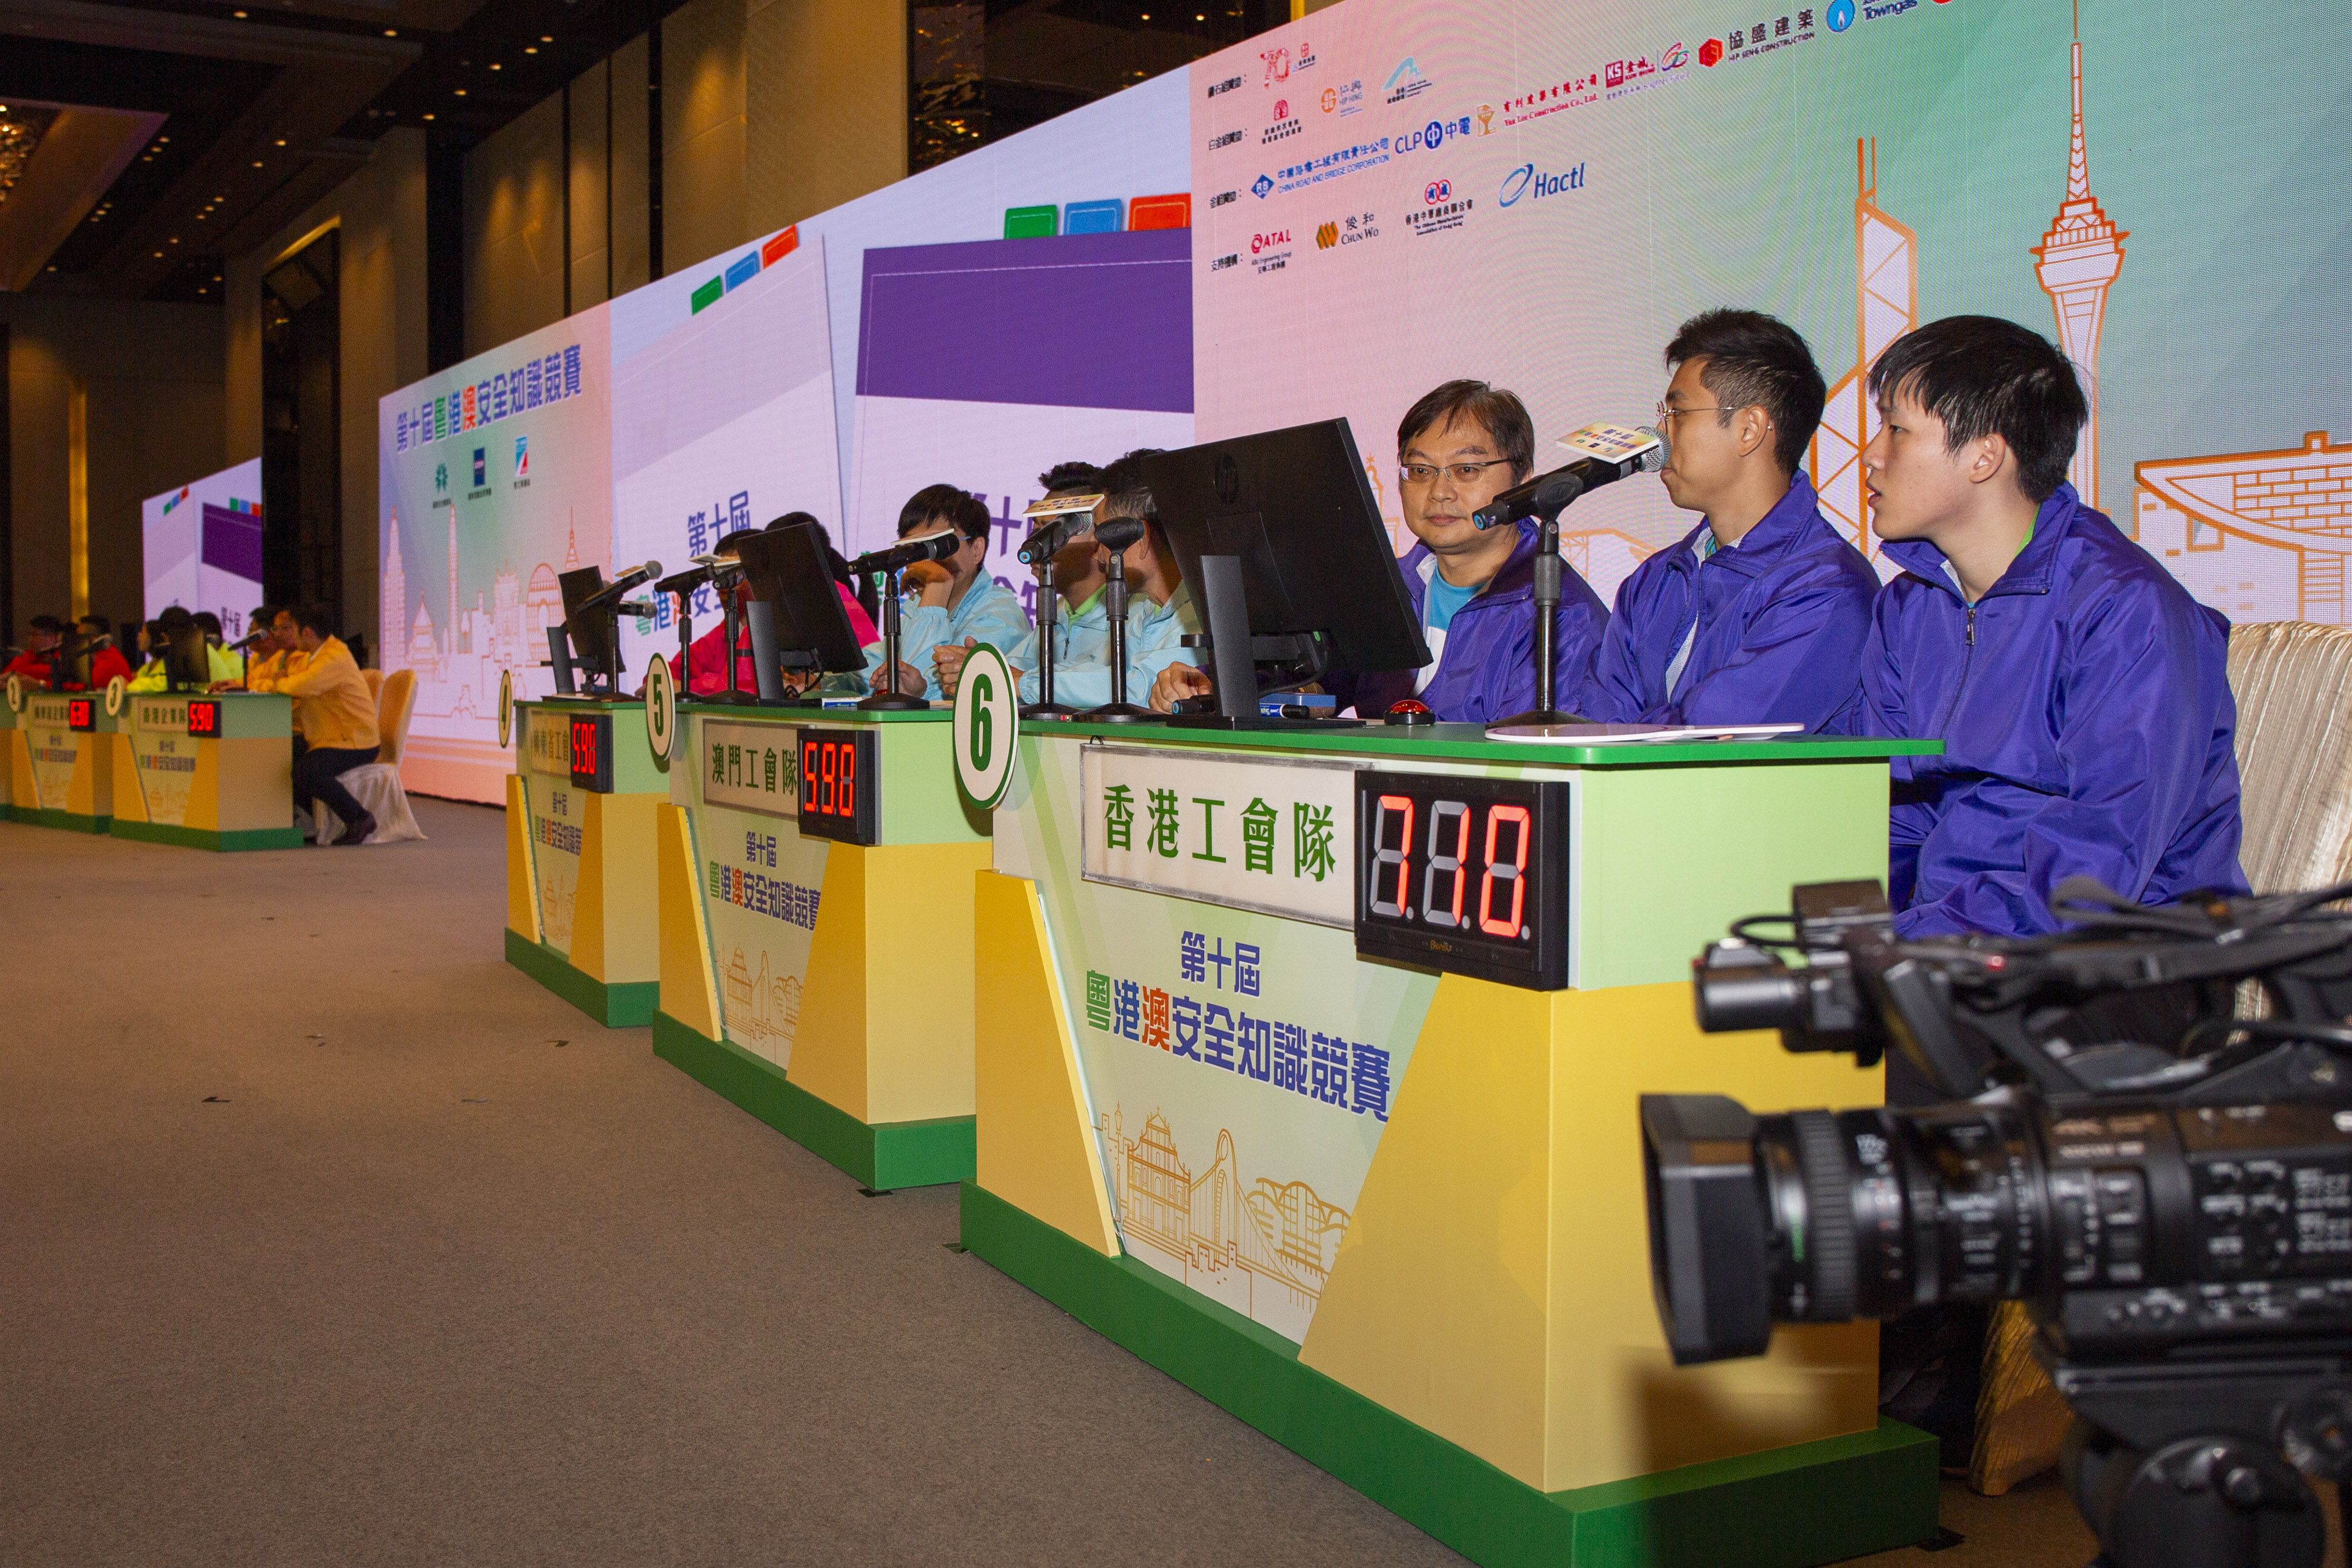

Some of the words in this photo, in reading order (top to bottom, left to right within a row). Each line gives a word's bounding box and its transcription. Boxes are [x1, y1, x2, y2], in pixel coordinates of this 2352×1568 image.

[1728, 8, 1814, 51] 協盛建築
[1863, 0, 1917, 21] Towngas
[1607, 62, 1622, 80] KS
[1529, 103, 1569, 119] Construction
[1395, 131, 1422, 154] CLP
[1445, 117, 1471, 139] 中電
[1534, 162, 1585, 199] Hactl
[1345, 212, 1374, 230] 俊和
[189, 704, 214, 731] 590
[502, 684, 507, 730] 4
[653, 673, 663, 737] 5
[971, 673, 993, 772] 6
[573, 723, 596, 774] 590
[712, 742, 797, 796] 澳門工會隊
[804, 741, 854, 817] 590
[747, 831, 776, 868] 第十屆
[1103, 784, 1336, 883] 香港工會隊
[1376, 795, 1530, 938] 710
[1181, 931, 1262, 997] 第十屆
[1085, 969, 1392, 1123] 粵港澳安全知識競賽
